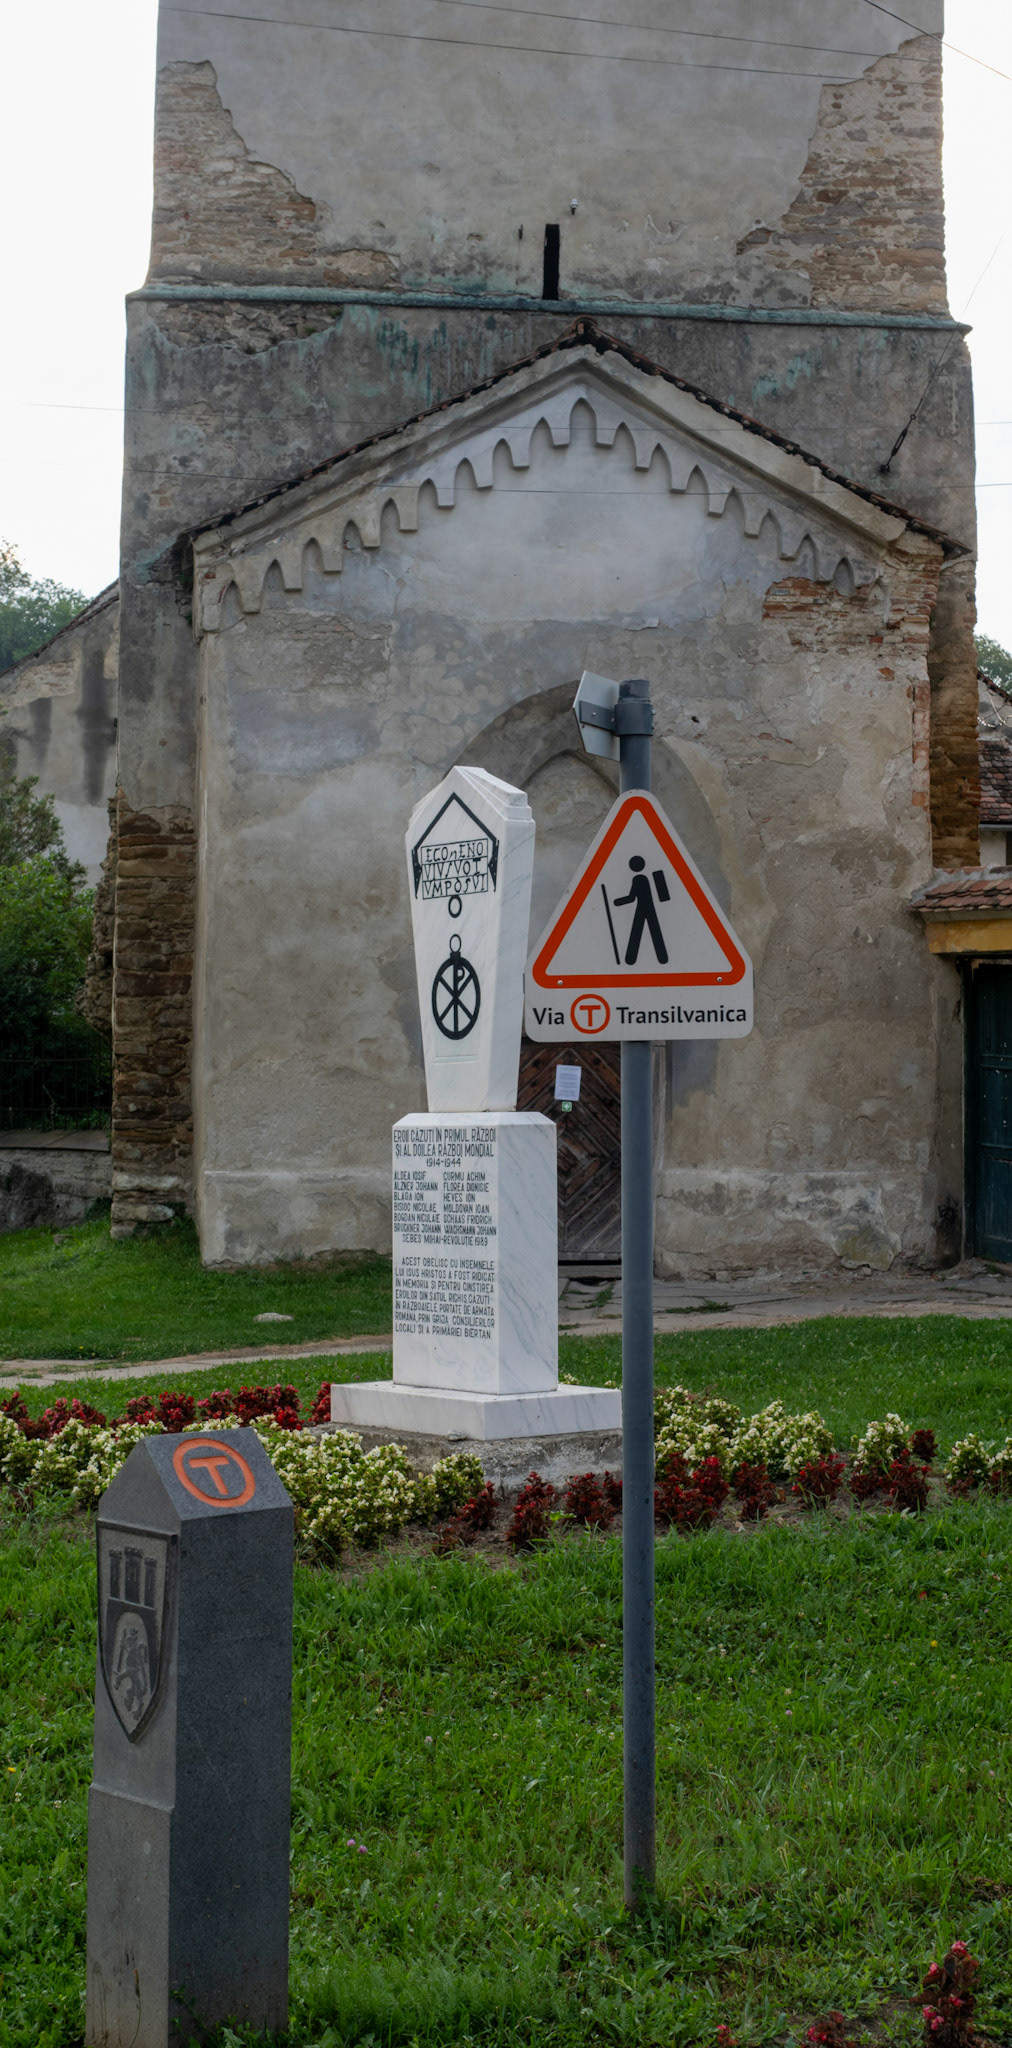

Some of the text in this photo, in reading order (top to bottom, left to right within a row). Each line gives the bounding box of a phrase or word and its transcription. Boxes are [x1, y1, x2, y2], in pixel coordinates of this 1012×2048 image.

[533, 1008, 565, 1025] Via
[616, 1005, 747, 1024] Transilvanica
[394, 1130, 409, 1142] EROII
[445, 1129, 469, 1142] PRIMUL
[403, 1144, 411, 1156] AL
[413, 1144, 436, 1157] DOILEA
[465, 1144, 494, 1157] MONDIAL
[426, 1158, 461, 1167] 1914-1944
[394, 1171, 426, 1180] ALDEA IOSIF
[467, 1172, 486, 1181] ACHIM
[394, 1182, 438, 1191] ALZNER JOHANN
[443, 1182, 489, 1192] FLOREA DIONISIE
[394, 1192, 424, 1201] BLAGA ION
[466, 1193, 475, 1202] ION
[443, 1204, 489, 1213] MOLDOVAN IOAN
[394, 1213, 415, 1222] BOGDAN
[421, 1224, 441, 1233] JOHANN
[477, 1226, 497, 1236] JOHANN
[474, 1237, 488, 1246] 1989
[402, 1257, 421, 1266] ACEST
[423, 1258, 448, 1267] OBELISC
[450, 1259, 458, 1268] CU
[395, 1267, 495, 1282] LUI ISUS HRISTOS A FOST RIDICAT
[403, 1279, 429, 1289] MEMORIA
[438, 1281, 461, 1291] PENTRU
[463, 1282, 494, 1293] CINSTIREA
[396, 1289, 417, 1299] EROILOR
[420, 1291, 428, 1300] DIN
[429, 1292, 446, 1302] SATUL
[439, 1304, 461, 1314] PURTATE
[464, 1305, 470, 1315] DE
[472, 1306, 494, 1316] ARMATA
[418, 1313, 430, 1323] PRIN
[432, 1314, 448, 1324] GRIJA
[452, 1316, 495, 1328] CONSILIERILOR
[396, 1323, 415, 1333] LOCALI
[465, 1328, 491, 1339] BIERTAN
